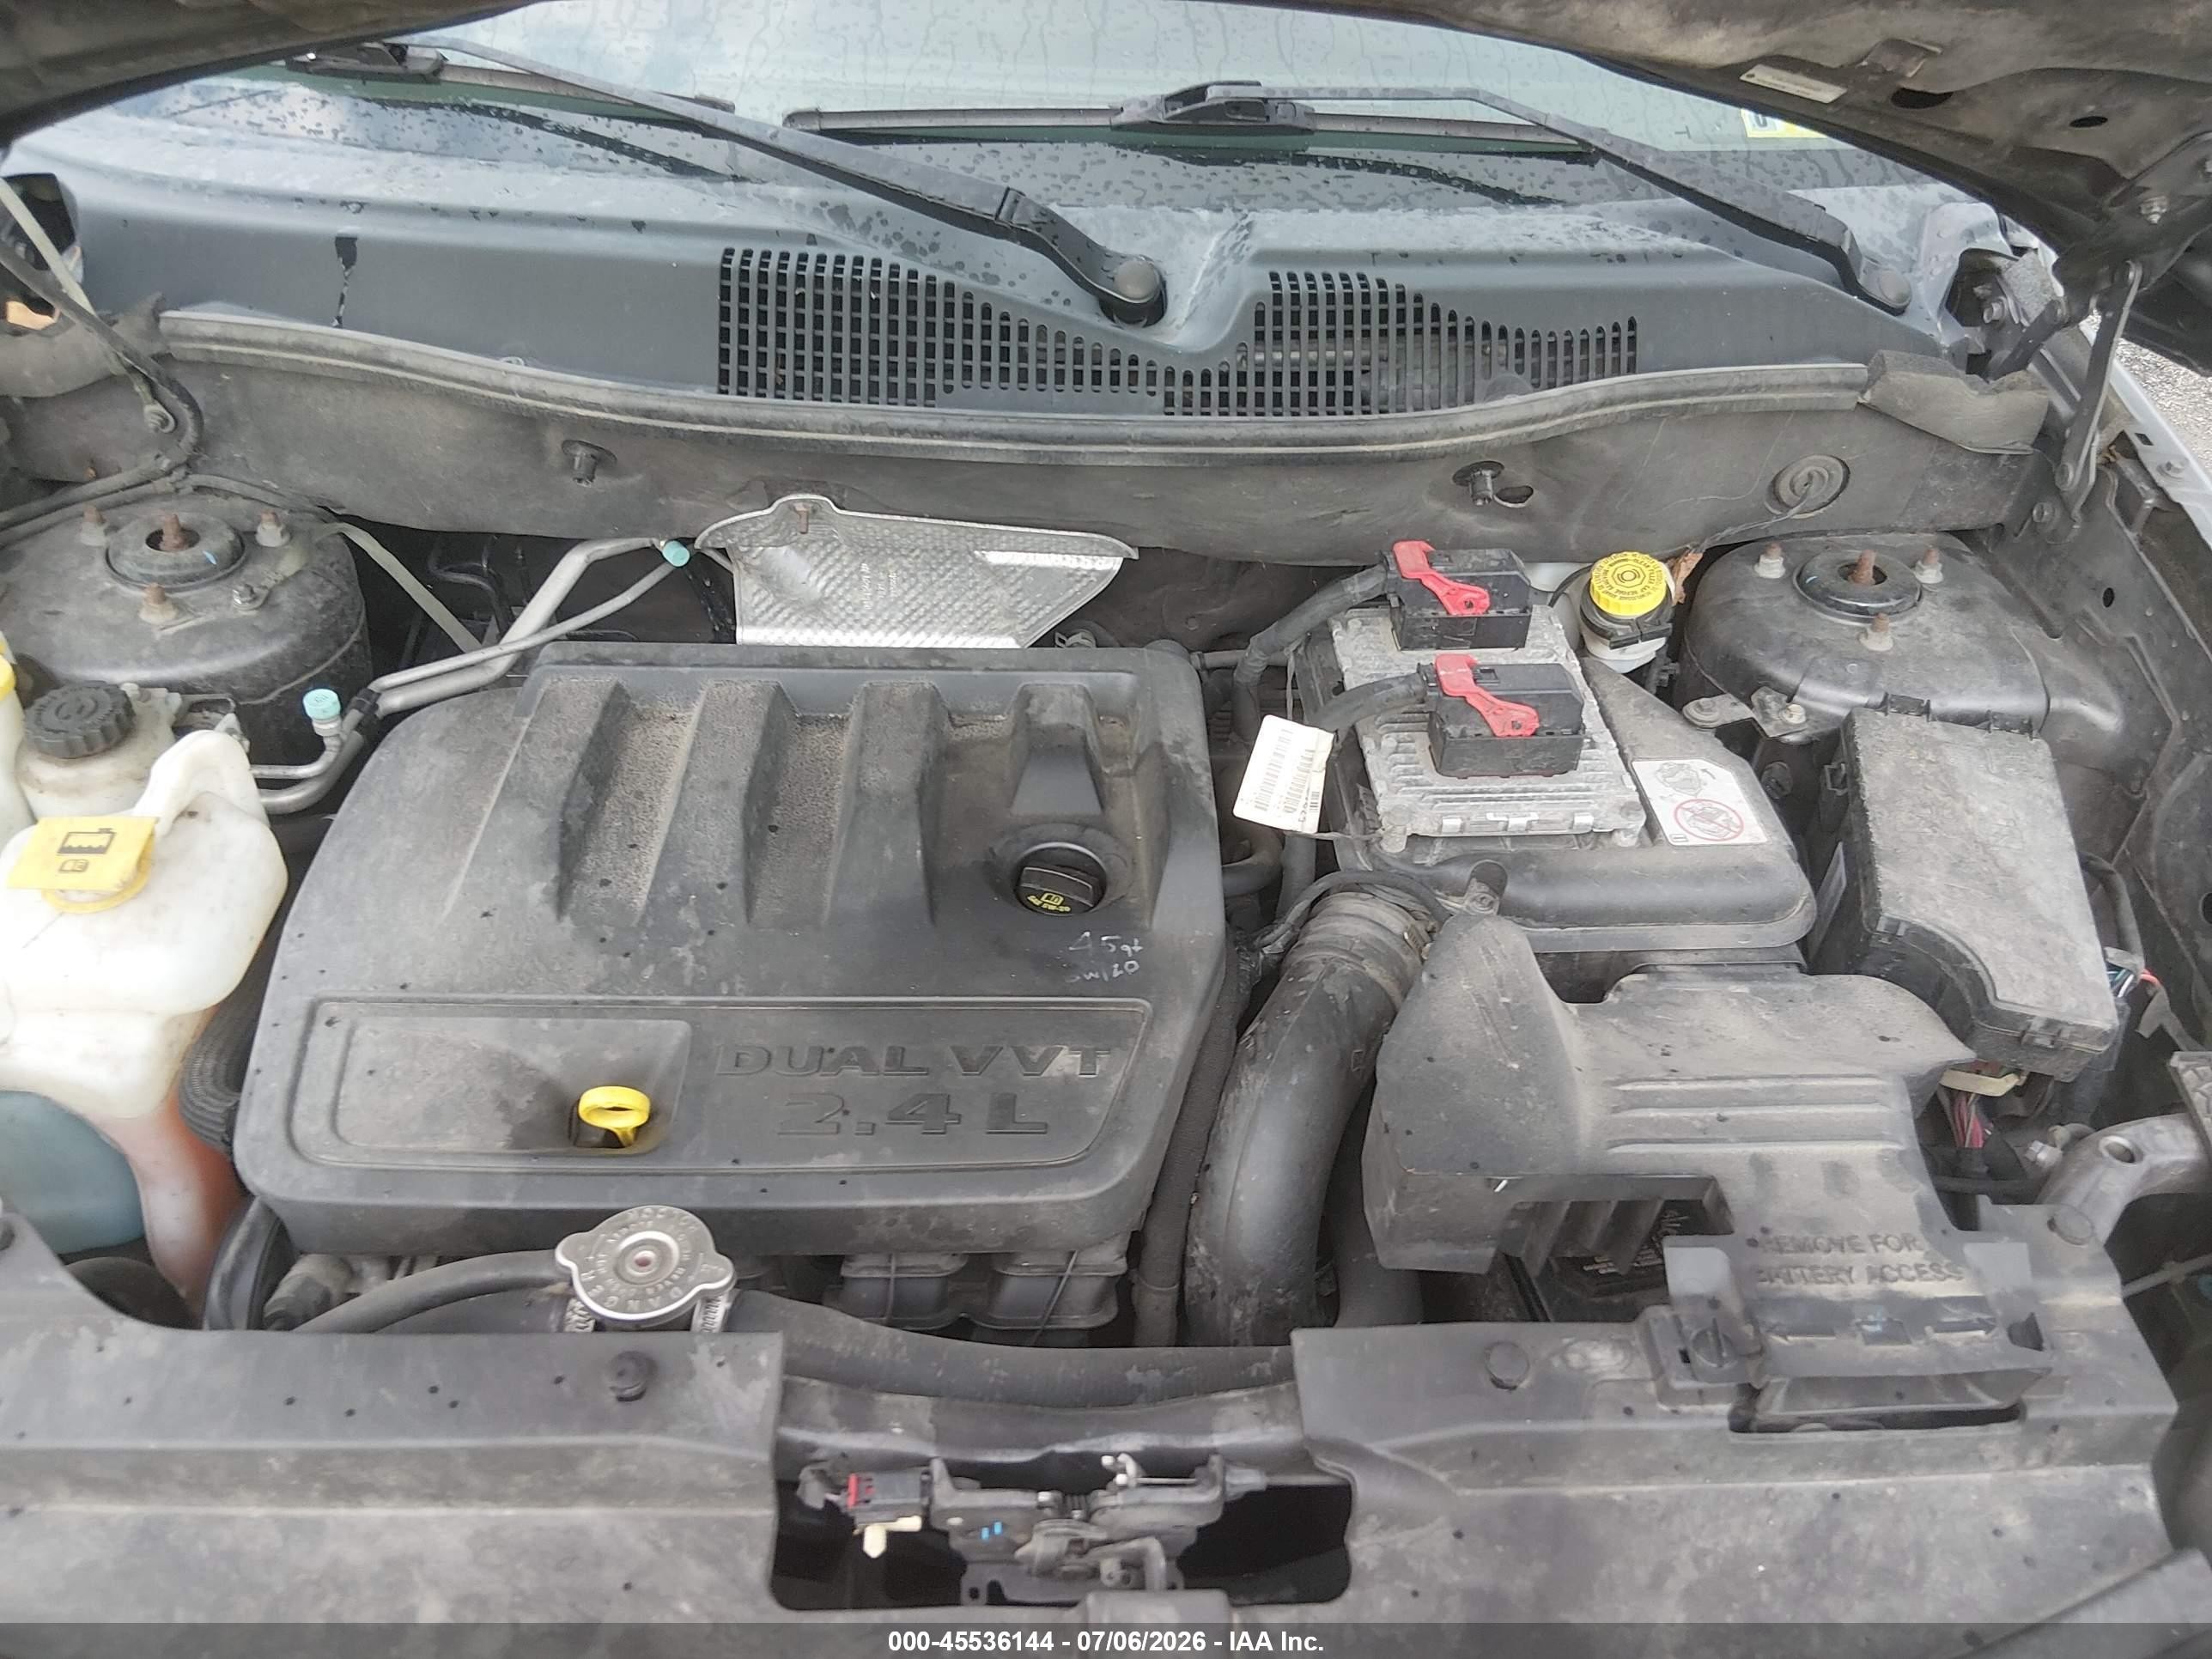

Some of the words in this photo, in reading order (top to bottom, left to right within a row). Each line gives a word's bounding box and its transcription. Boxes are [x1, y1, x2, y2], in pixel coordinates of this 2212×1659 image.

[714, 1045, 929, 1077] DUAL
[949, 1045, 1110, 1078] VVT
[1868, 1232, 1925, 1254] FOR
[1866, 1261, 1966, 1285] ACCESS
